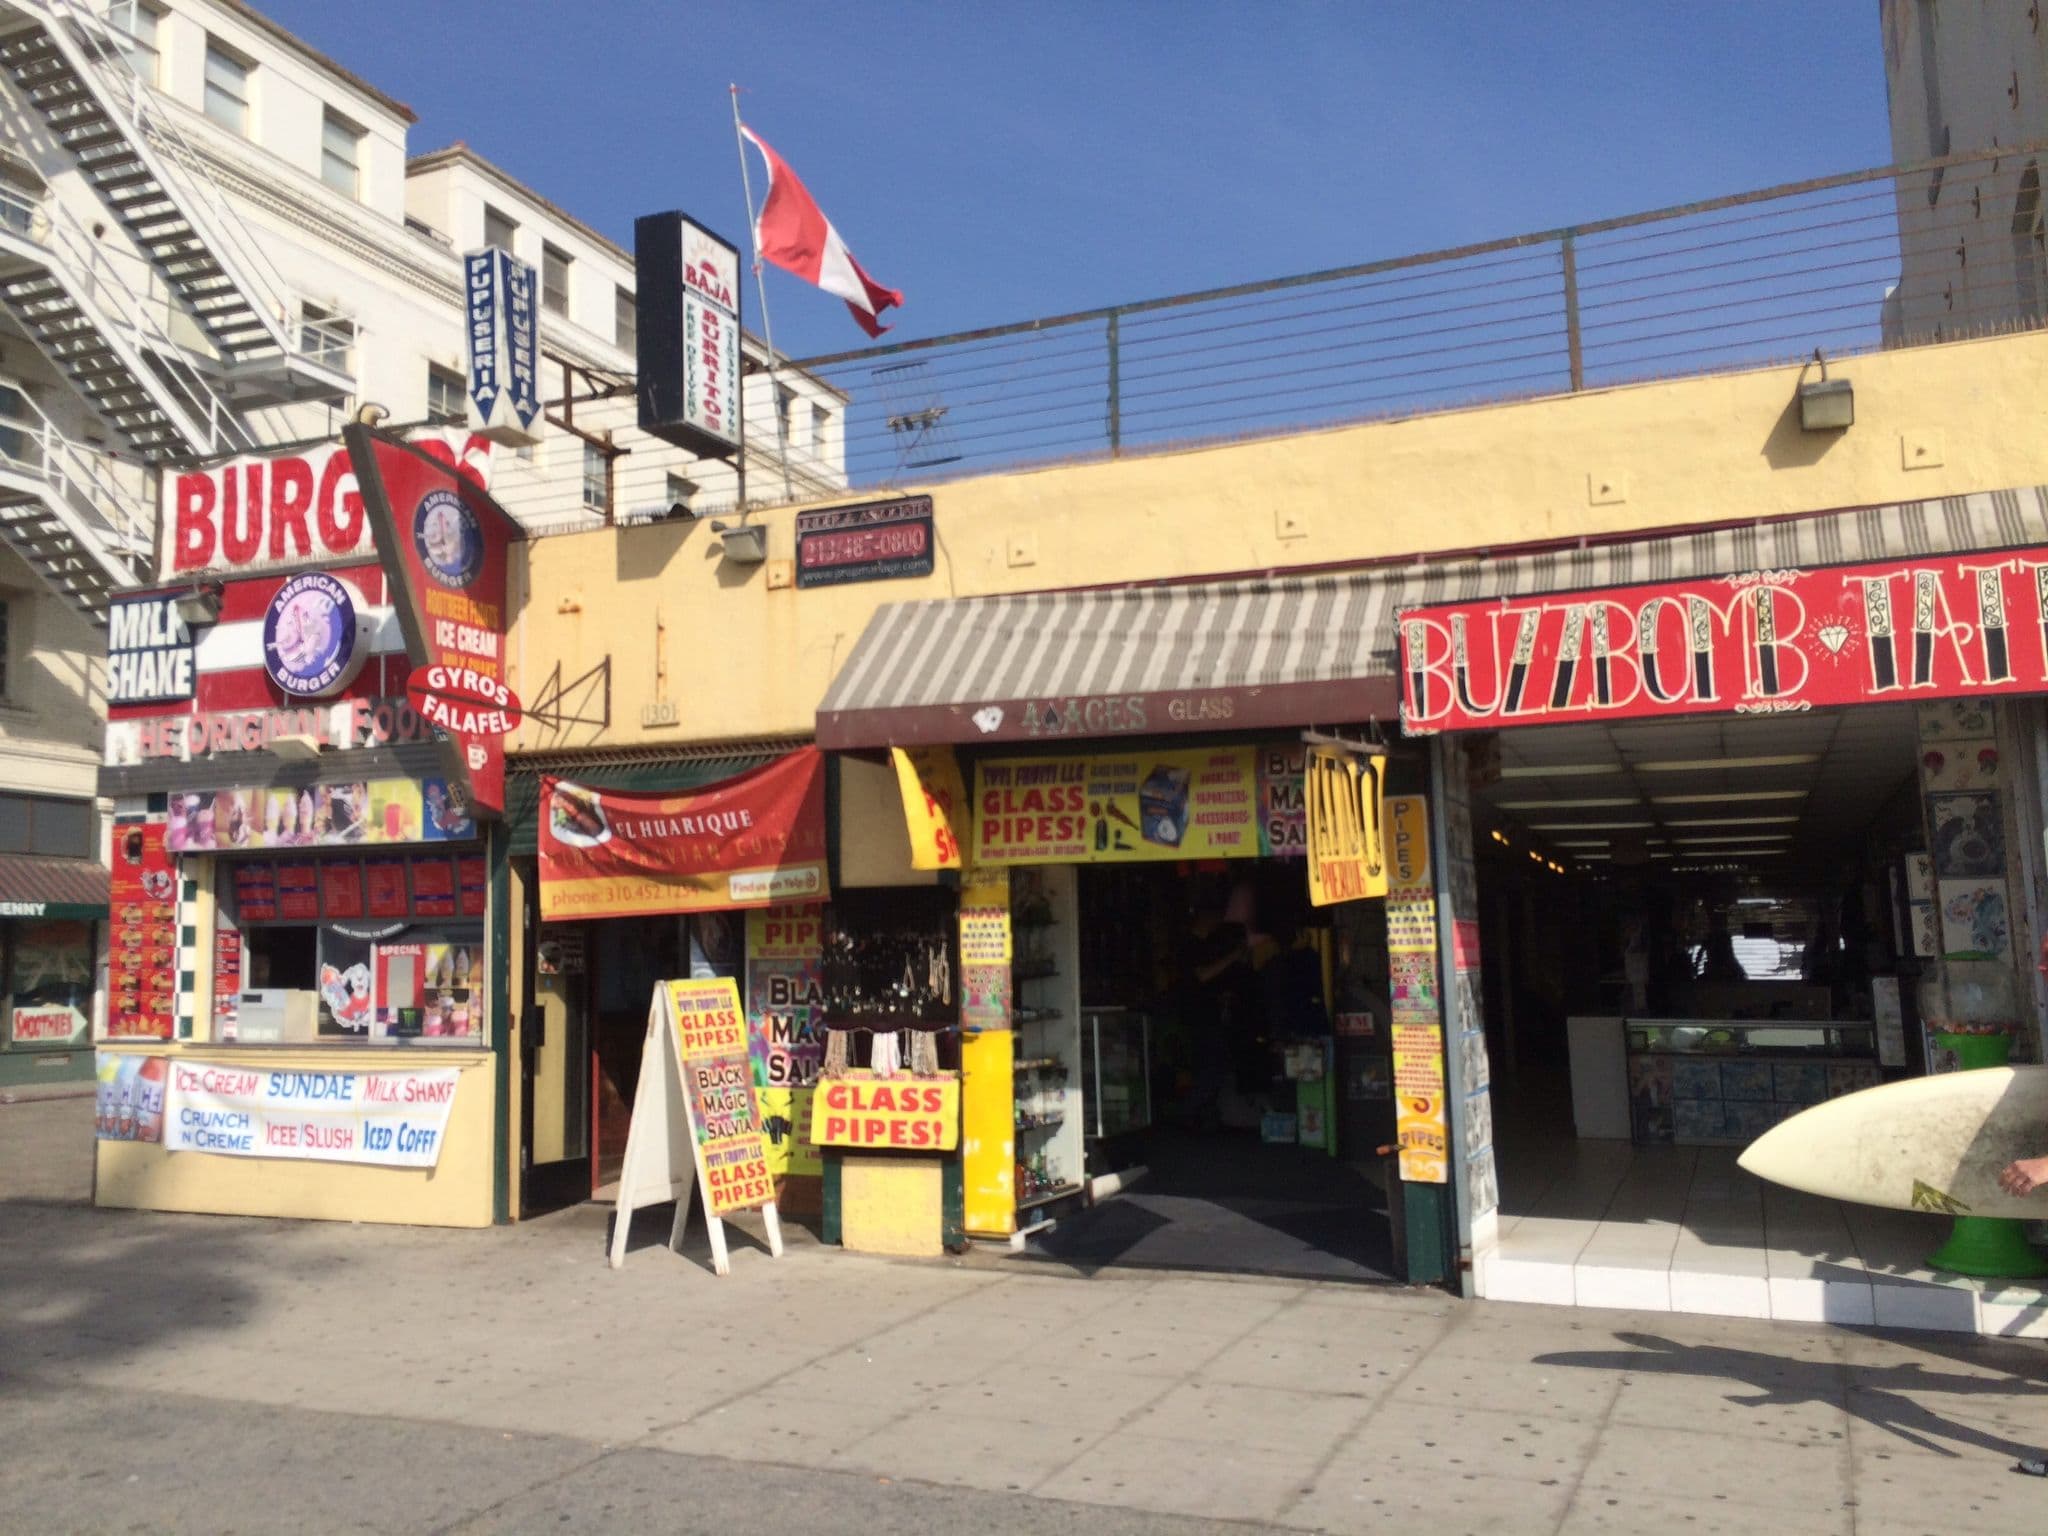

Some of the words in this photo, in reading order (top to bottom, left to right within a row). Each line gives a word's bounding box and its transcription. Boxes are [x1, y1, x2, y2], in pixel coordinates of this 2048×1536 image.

[685, 262, 732, 309] BAJA
[471, 259, 495, 401] PUPUSERIA
[511, 264, 533, 416] PUPUSERIA
[702, 308, 721, 431] BURRITOS
[275, 576, 346, 612] AMERICAN
[109, 600, 191, 651] MILK
[435, 619, 456, 649] ICE
[457, 624, 497, 658] CREAM
[1401, 584, 1809, 720] BUZZBOMB
[106, 647, 192, 700] SHAKE
[277, 661, 340, 691] BURGER
[427, 667, 509, 706] GYROS
[422, 694, 512, 735] FALAFEL
[1061, 697, 1148, 734] ACES
[1168, 698, 1234, 721] GLASS
[188, 705, 330, 755] ORIGINAL
[982, 785, 1085, 815] GLASS
[615, 819, 637, 840] EL
[641, 808, 754, 839] HUARIQUE
[982, 816, 1087, 845] PIPES!
[1394, 802, 1412, 879] PIPES
[766, 923, 822, 945] PIP
[379, 945, 422, 956] SPECIAL
[771, 978, 822, 1005] BLA
[681, 1011, 737, 1030] GLASS
[685, 1028, 740, 1048] PIPES!
[175, 1065, 200, 1092] ICE
[202, 1067, 258, 1096] CREAM
[267, 1071, 355, 1100] SUNDAE
[363, 1075, 403, 1102] MILK
[698, 1068, 742, 1088] BLACK
[703, 1093, 746, 1114] MAGIC
[826, 1085, 942, 1112] GLASS
[180, 1108, 250, 1128] CRUNCH
[706, 1118, 752, 1140] SALVIA
[825, 1117, 943, 1145] PIPES!
[195, 1129, 254, 1150] CREME
[363, 1120, 393, 1150] ICED
[1400, 1130, 1444, 1151] PIPES
[709, 1160, 767, 1186] GLASS
[713, 1178, 771, 1206] PIPES!
